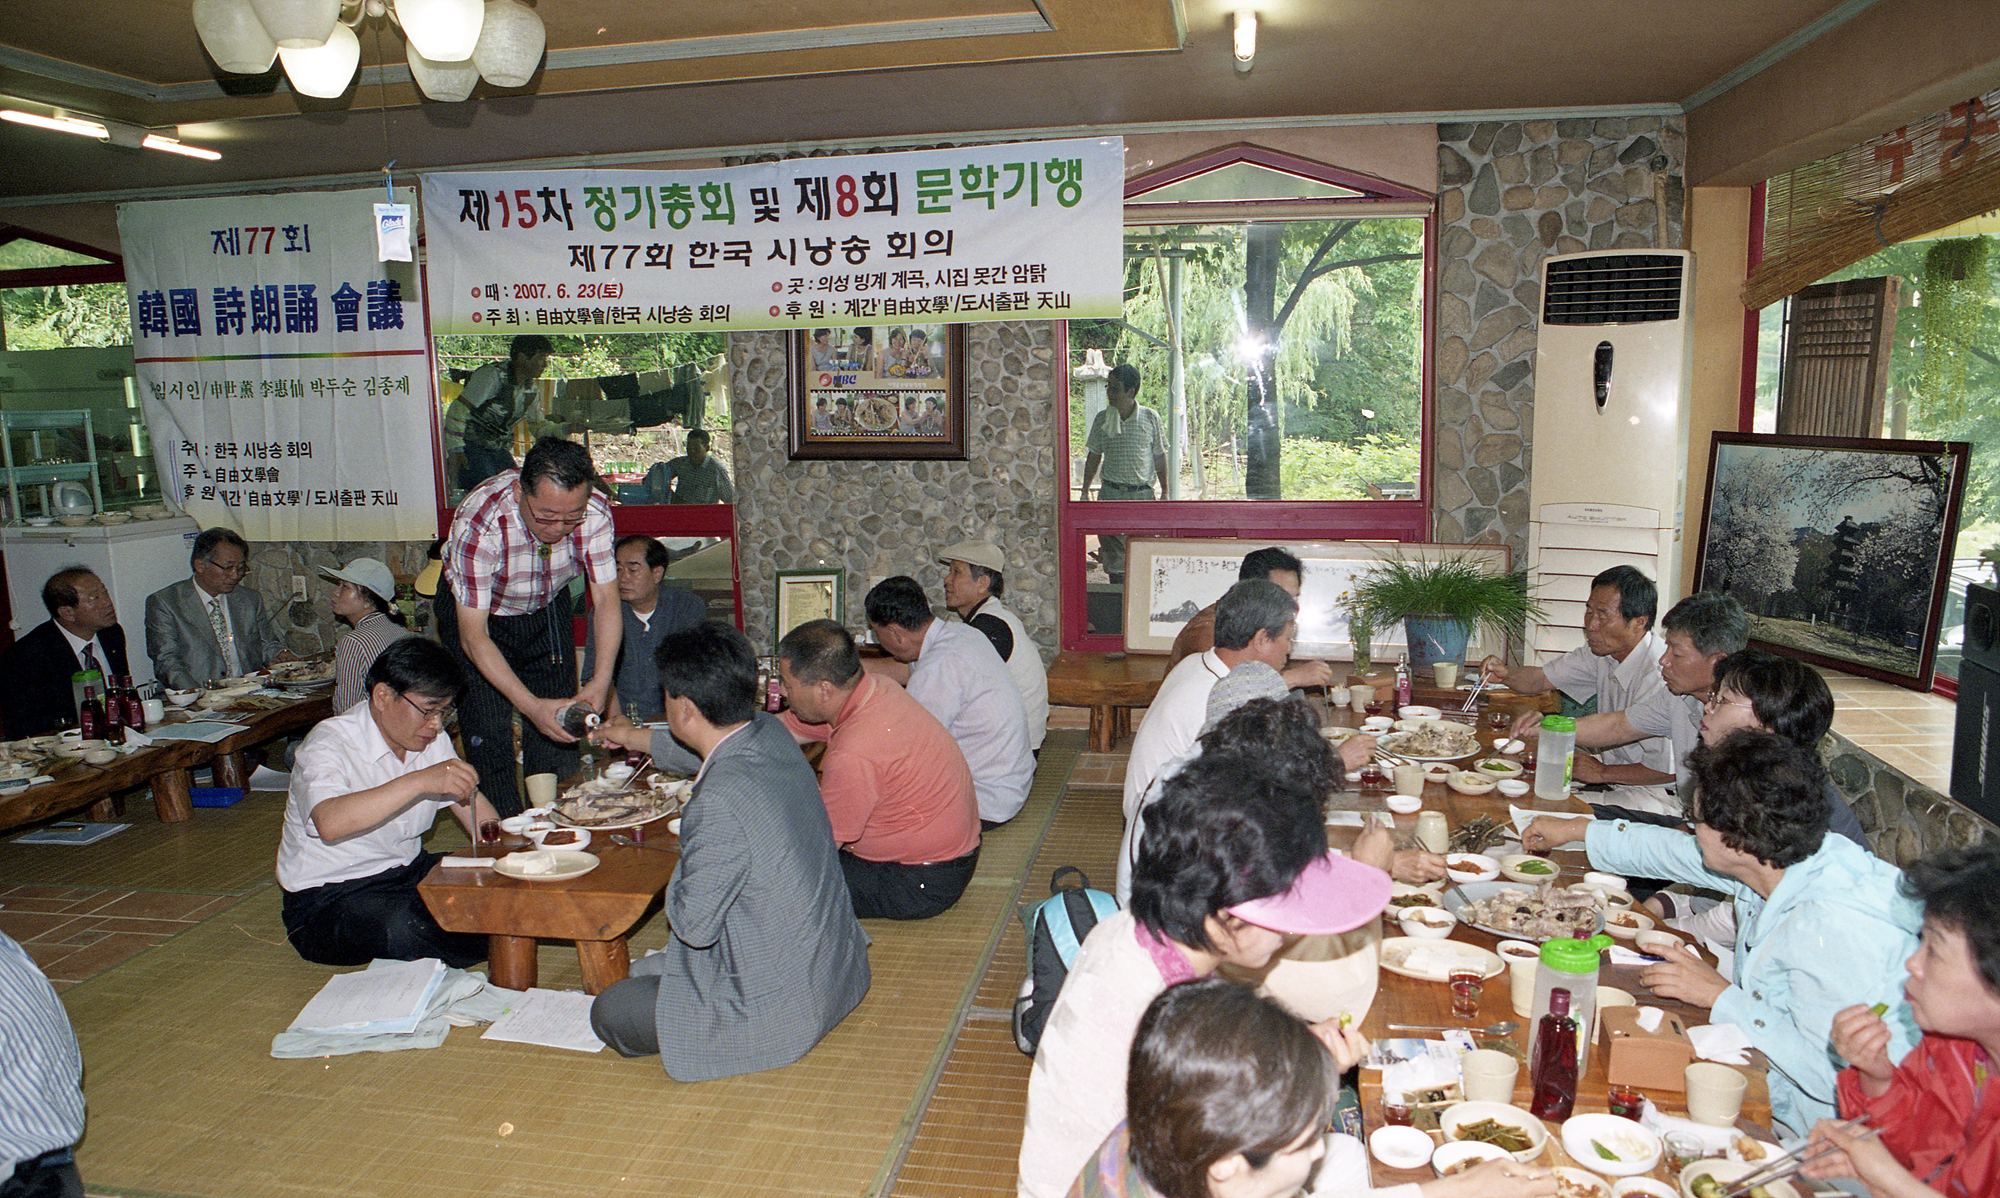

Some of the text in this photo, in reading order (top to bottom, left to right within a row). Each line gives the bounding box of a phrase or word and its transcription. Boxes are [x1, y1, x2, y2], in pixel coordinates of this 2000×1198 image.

[458, 157, 1083, 232] 제15차 정기총회 및 제8회 문학기행
[211, 224, 310, 256] 제77회
[568, 229, 953, 272] 제77회 한국 시낭송 회의
[788, 278, 805, 295] 곳
[817, 274, 850, 292] 의성
[854, 272, 887, 291] 빙계
[891, 270, 930, 289] 계곡,
[934, 268, 968, 288] 시집
[973, 266, 1008, 286] 못간
[1012, 263, 1047, 284] 암탉
[485, 283, 499, 301] 때
[513, 283, 551, 299] 2007.
[577, 282, 624, 300] 23(토)
[1037, 290, 1071, 310] 天山
[138, 279, 405, 338] 韓國 詩朗誦 會議
[646, 305, 693, 324] 시낭송
[699, 304, 730, 322] 회의
[310, 377, 357, 398] 박두순
[363, 375, 410, 396] 김종제
[214, 442, 238, 459] 한국
[243, 441, 282, 459] 시낭송
[286, 441, 313, 458] 회의
[215, 466, 279, 483] 自由文學會
[371, 489, 398, 507] 天山
